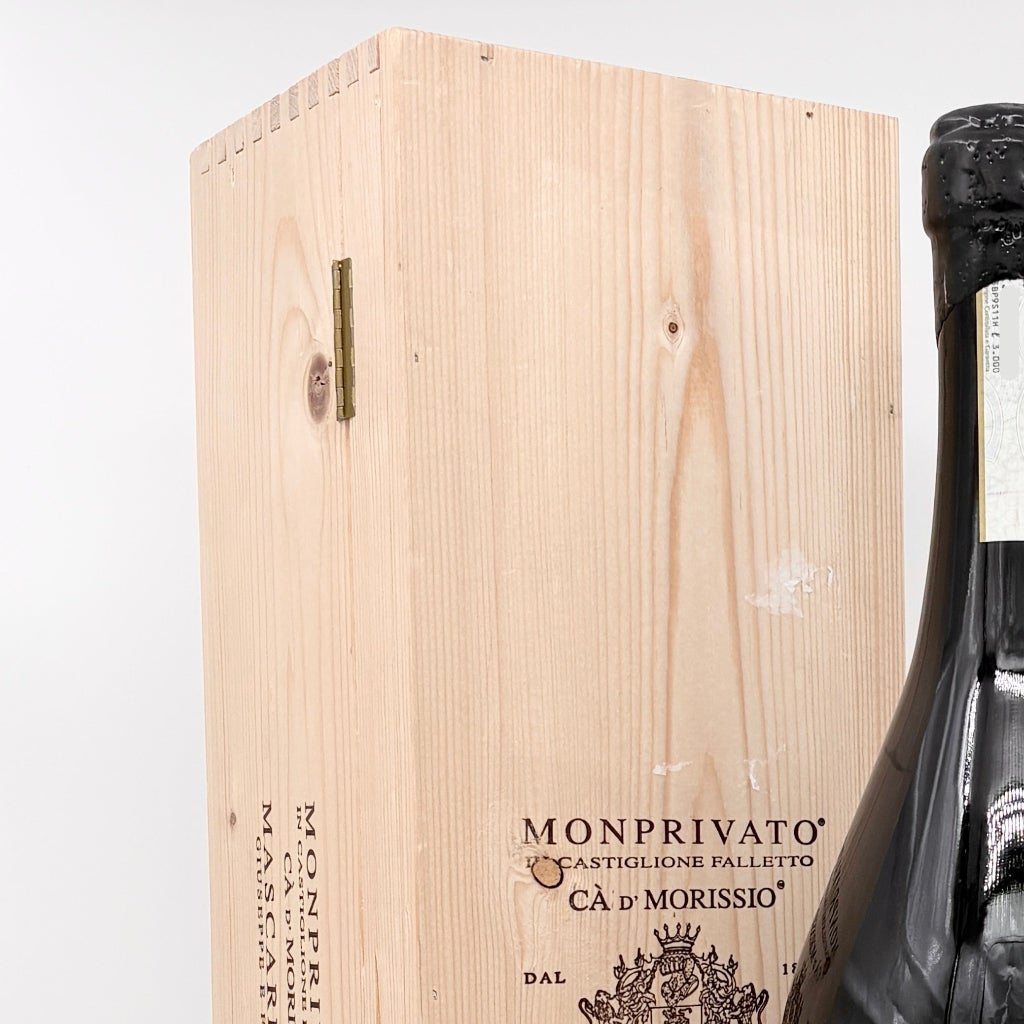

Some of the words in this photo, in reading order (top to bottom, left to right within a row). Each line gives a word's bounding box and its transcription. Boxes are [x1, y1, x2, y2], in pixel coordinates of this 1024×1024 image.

[296, 806, 302, 831] IN
[283, 852, 295, 897] CÀ
[558, 855, 705, 869] CASTIGLIONE
[711, 855, 814, 868] FALLETTO
[256, 836, 265, 970] GIUSEPPE
[568, 883, 611, 911] CÀ
[297, 839, 308, 1011] CASTIGLIONE
[524, 971, 567, 985] DAL
[259, 985, 265, 999] E
